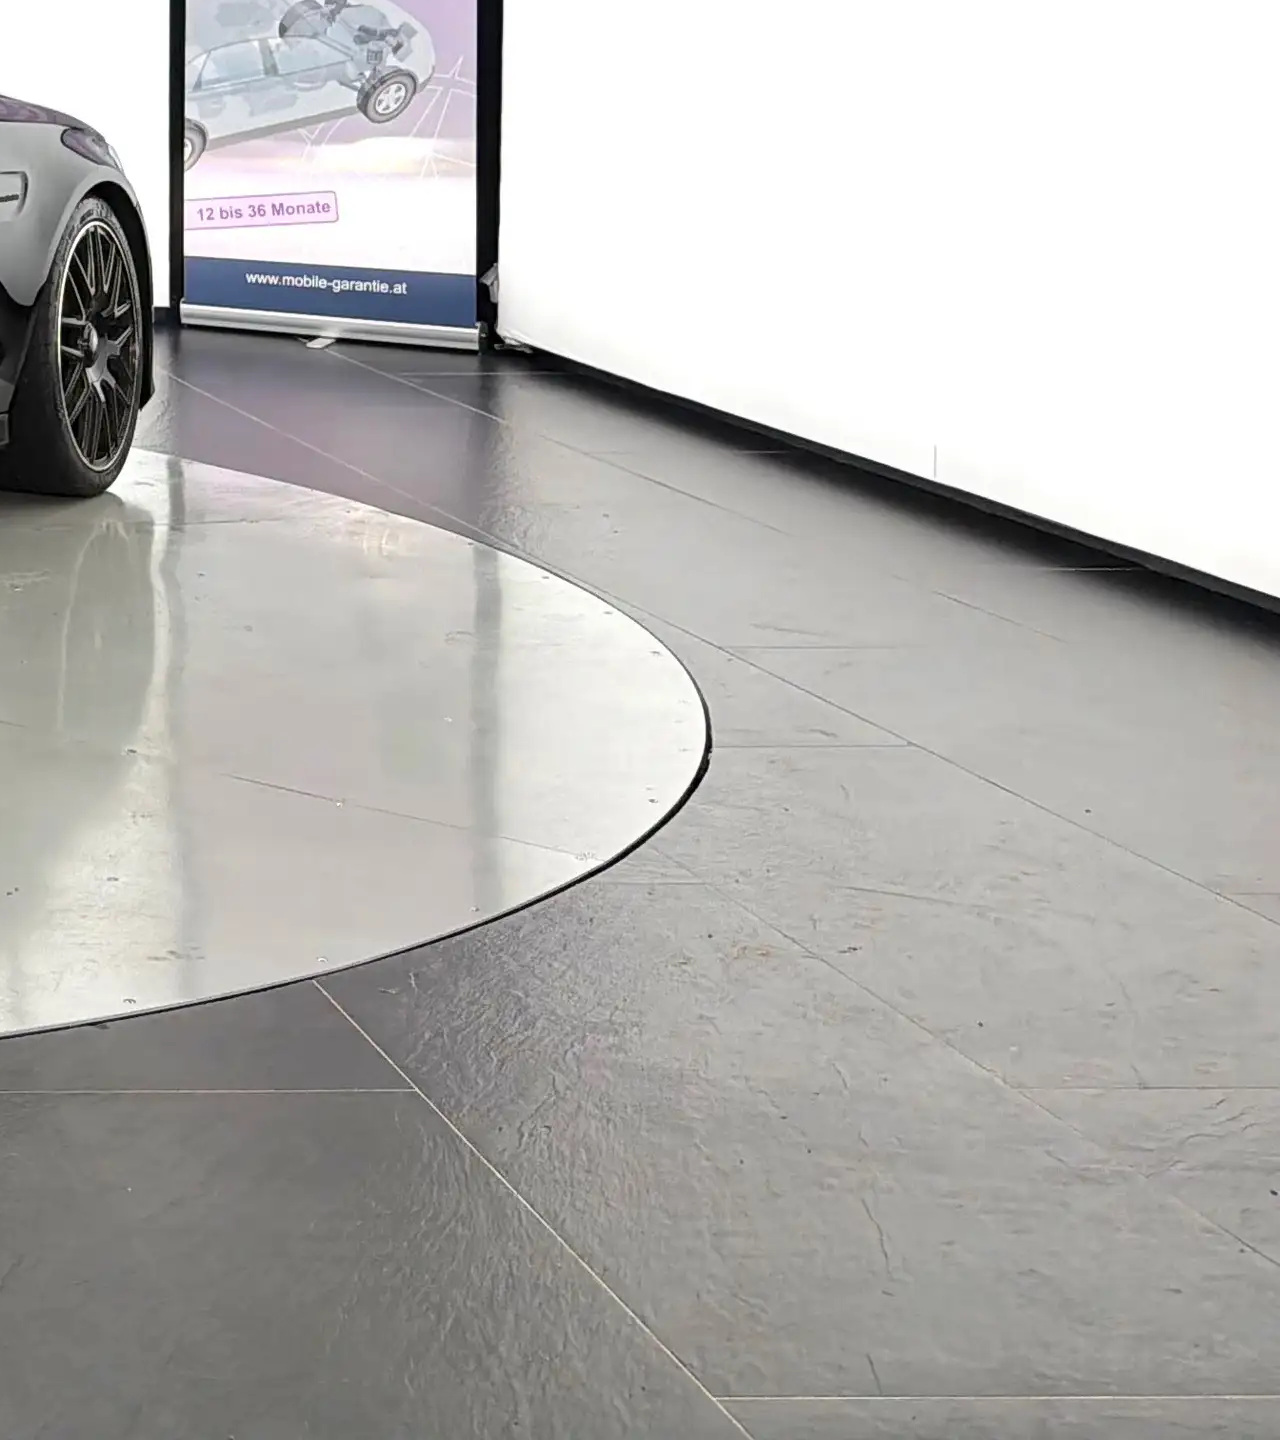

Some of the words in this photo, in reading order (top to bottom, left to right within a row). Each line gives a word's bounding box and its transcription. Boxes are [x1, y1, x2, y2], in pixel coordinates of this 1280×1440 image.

[197, 207, 215, 221] 12
[219, 205, 244, 220] bis
[248, 203, 267, 218] 36
[271, 201, 331, 217] Monate
[245, 271, 408, 295] www.mobile-garantie.at
